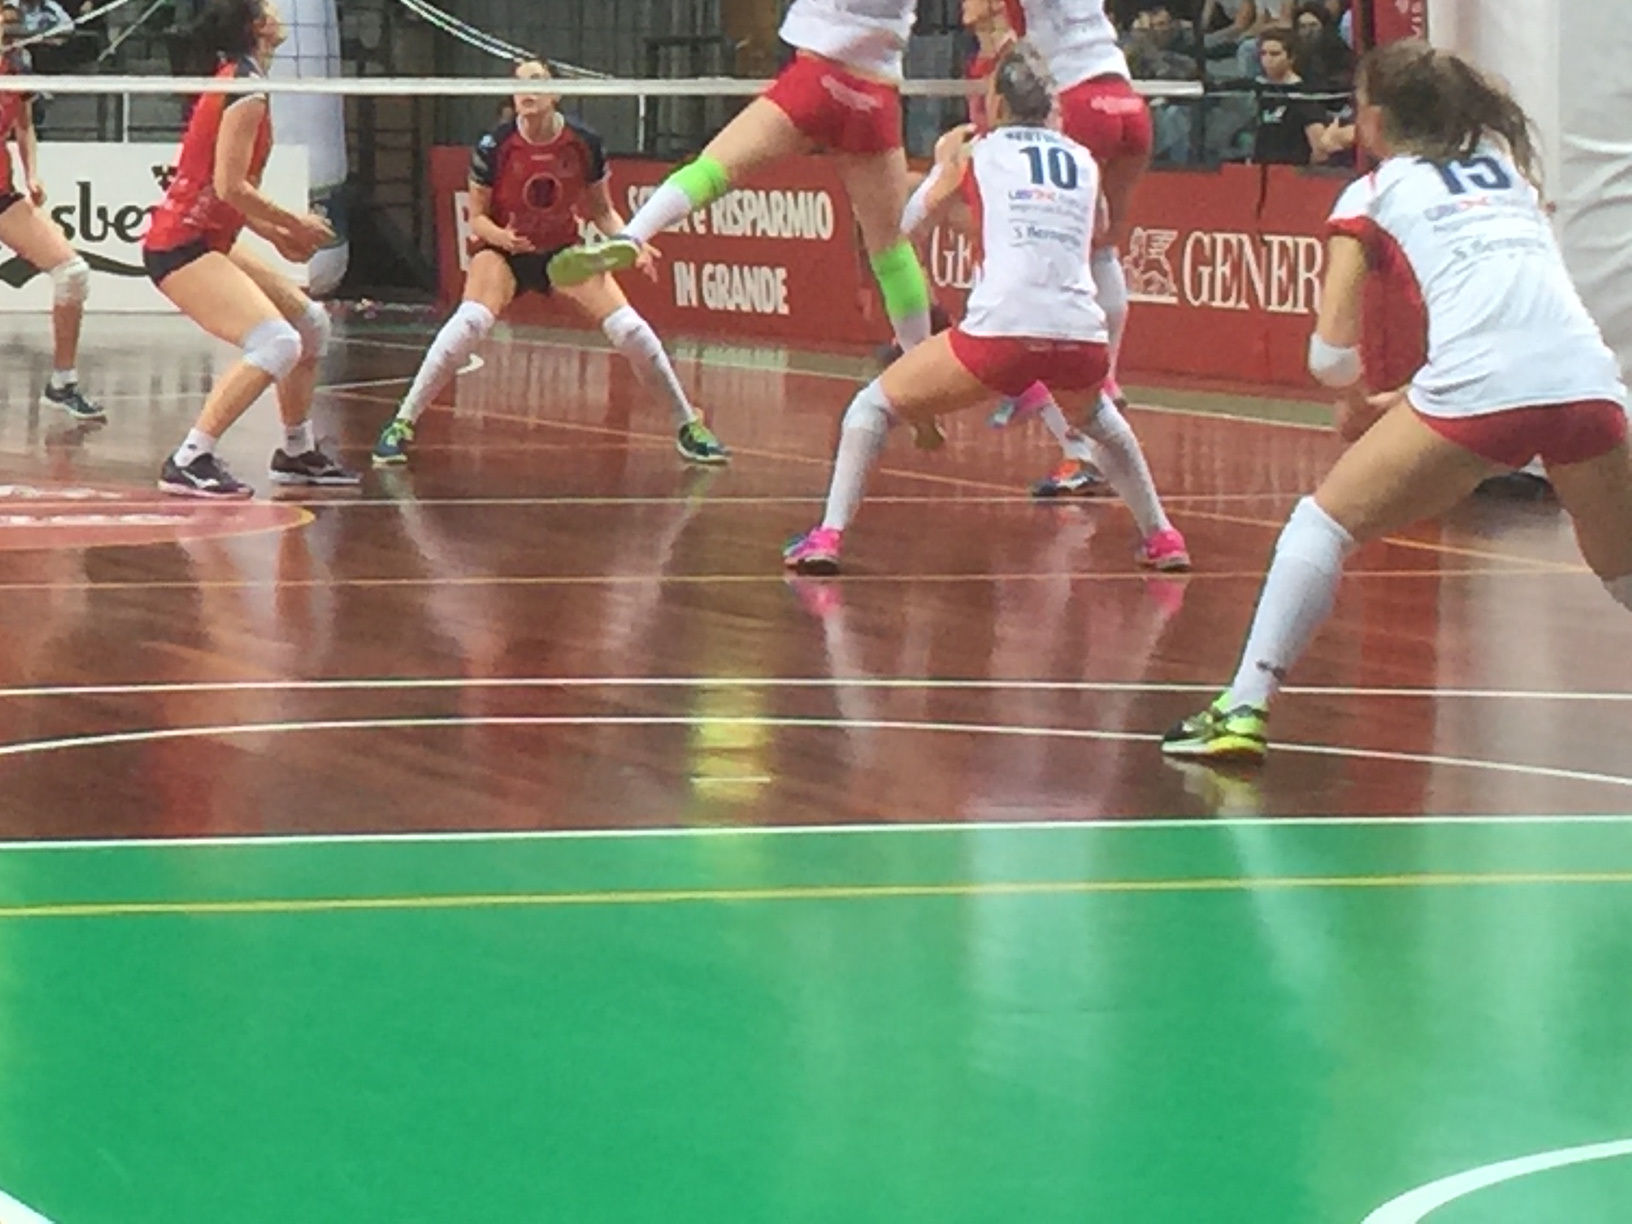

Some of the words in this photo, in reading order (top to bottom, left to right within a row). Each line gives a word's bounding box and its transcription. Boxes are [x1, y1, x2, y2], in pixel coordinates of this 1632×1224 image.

[1018, 145, 1079, 191] 10
[1415, 156, 1513, 195] 15
[711, 187, 835, 241] RISPARMIO
[674, 260, 699, 308] IN
[701, 262, 791, 316] GRANDE
[1183, 231, 1325, 315] GENER
